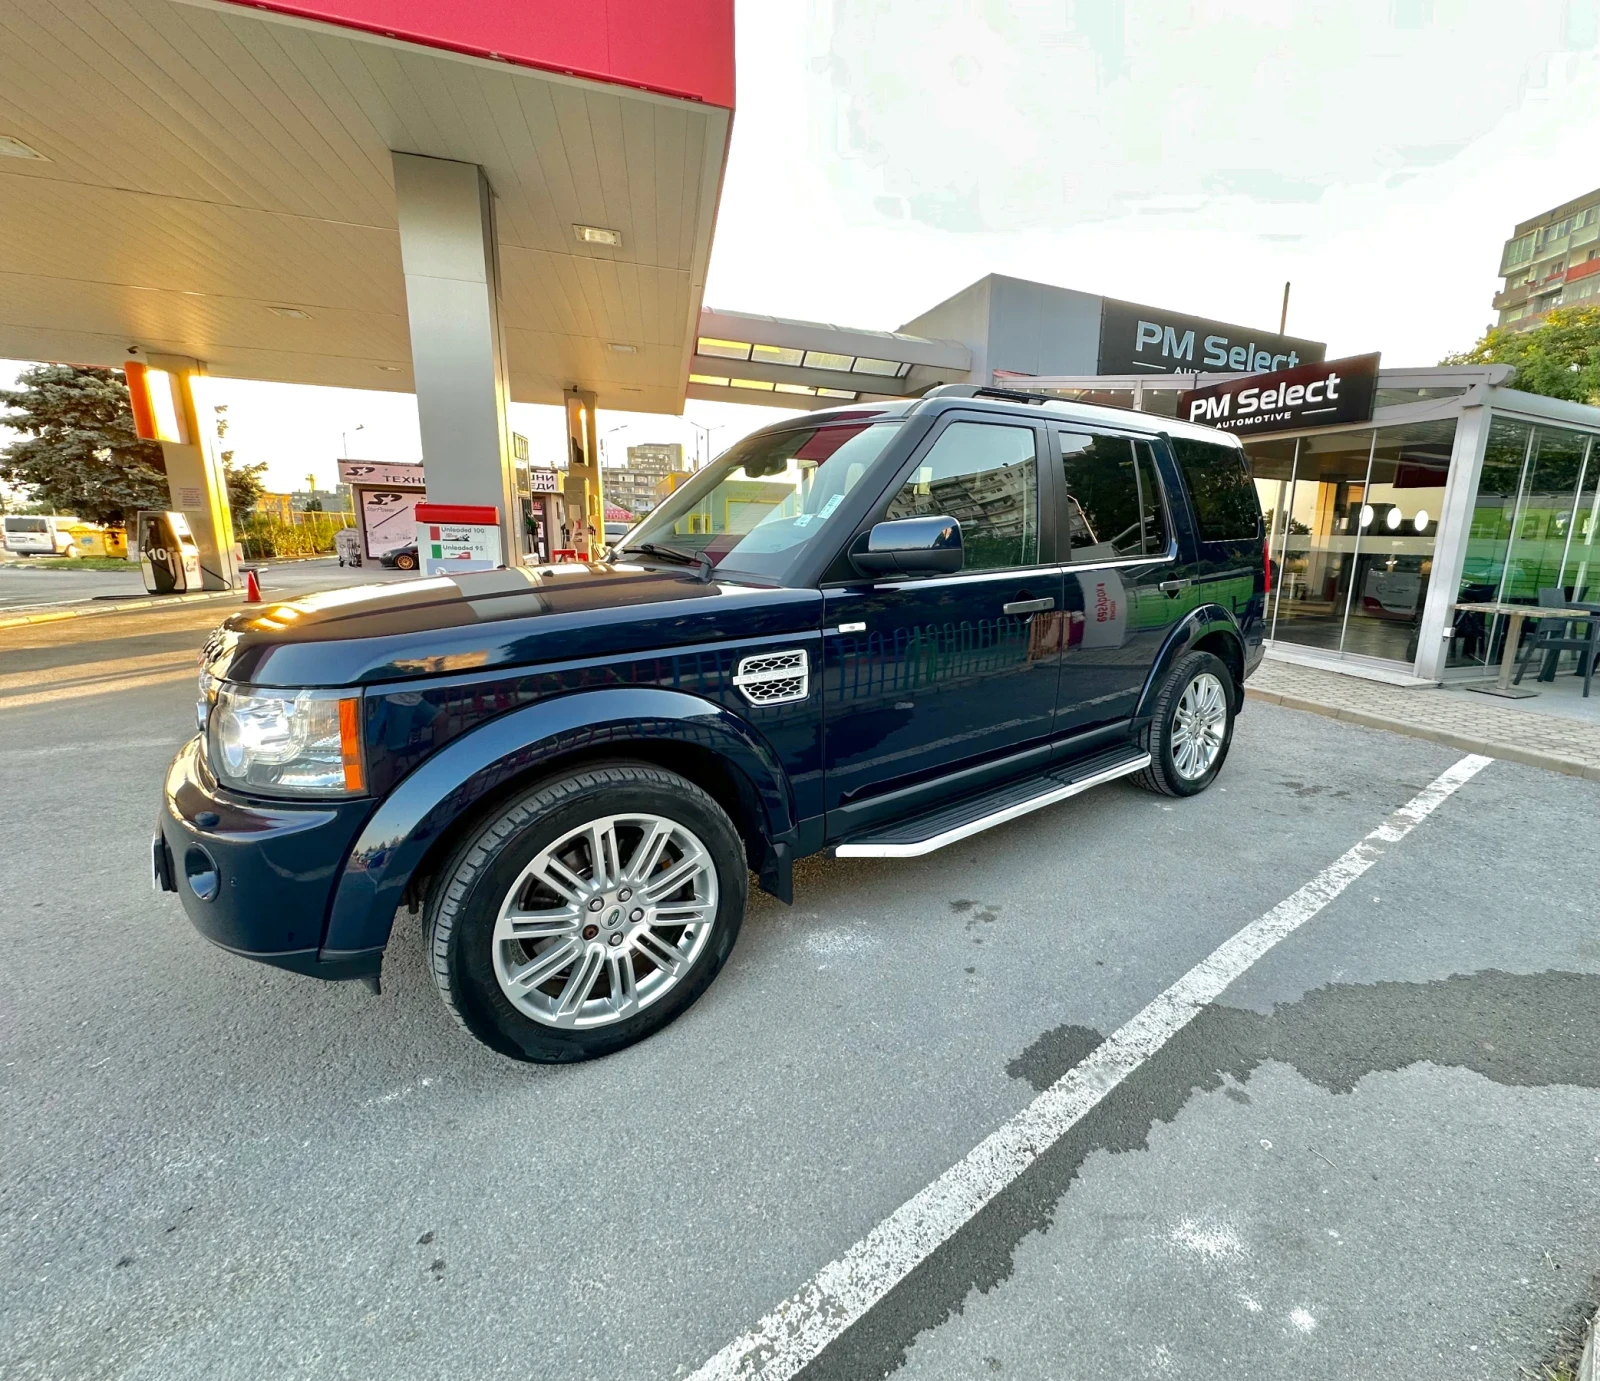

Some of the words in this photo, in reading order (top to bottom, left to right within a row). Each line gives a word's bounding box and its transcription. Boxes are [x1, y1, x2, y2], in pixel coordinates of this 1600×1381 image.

[1135, 321, 1195, 361] PM
[1203, 334, 1300, 373] Select
[1173, 366, 1209, 375] AUT
[1190, 393, 1231, 423] PM
[1237, 373, 1341, 413] Select
[1215, 411, 1293, 430] AUTOMOTIVE
